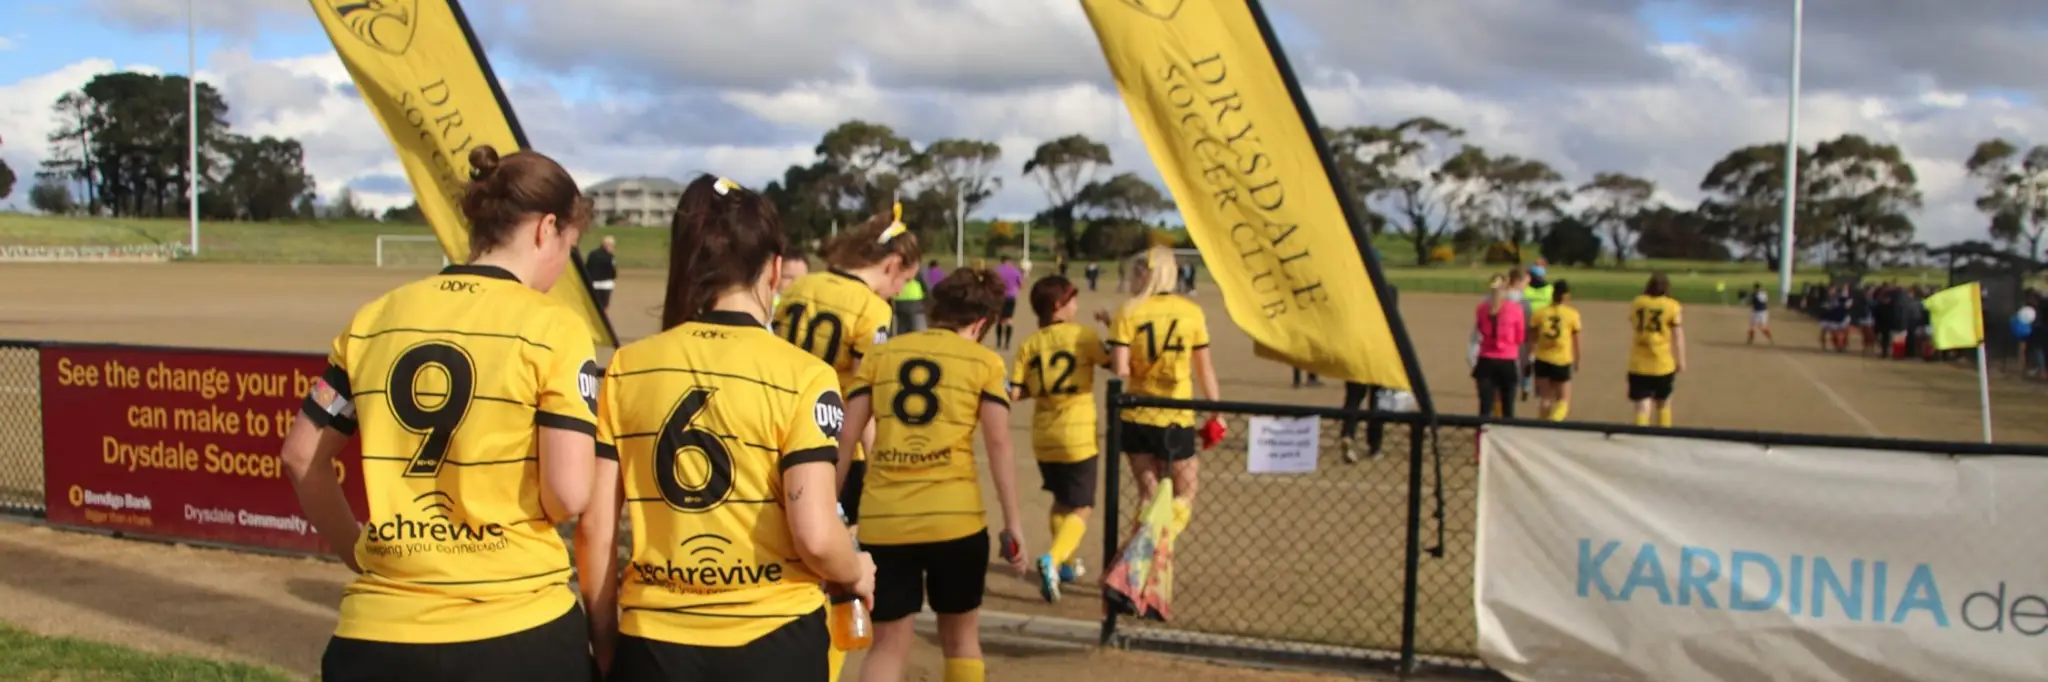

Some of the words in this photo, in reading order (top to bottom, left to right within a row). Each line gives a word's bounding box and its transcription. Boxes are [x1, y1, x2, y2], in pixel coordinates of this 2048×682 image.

[420, 77, 472, 178] DRY
[1158, 63, 1238, 212] SOCCER
[1230, 222, 1288, 321] CLUB
[1191, 53, 1328, 311] DRYSDALE
[786, 303, 842, 366] 10
[1136, 319, 1184, 364] 14
[1546, 315, 1561, 340] 3
[1635, 307, 1663, 334] 13
[57, 357, 99, 387] See
[104, 361, 140, 389] the
[146, 362, 230, 399] change
[235, 371, 288, 401] your
[892, 357, 942, 425] 8
[1029, 350, 1079, 396] 12
[128, 404, 167, 430] can
[174, 405, 240, 434] make
[246, 408, 270, 437] to
[386, 339, 477, 478] 9
[103, 437, 199, 473] Drysdale
[204, 444, 282, 478] Soccer
[653, 384, 736, 514] 6
[184, 504, 236, 524] Drysdale
[238, 509, 307, 535] Community
[1576, 538, 1951, 628] KARDINIA
[1961, 582, 2048, 636] de
